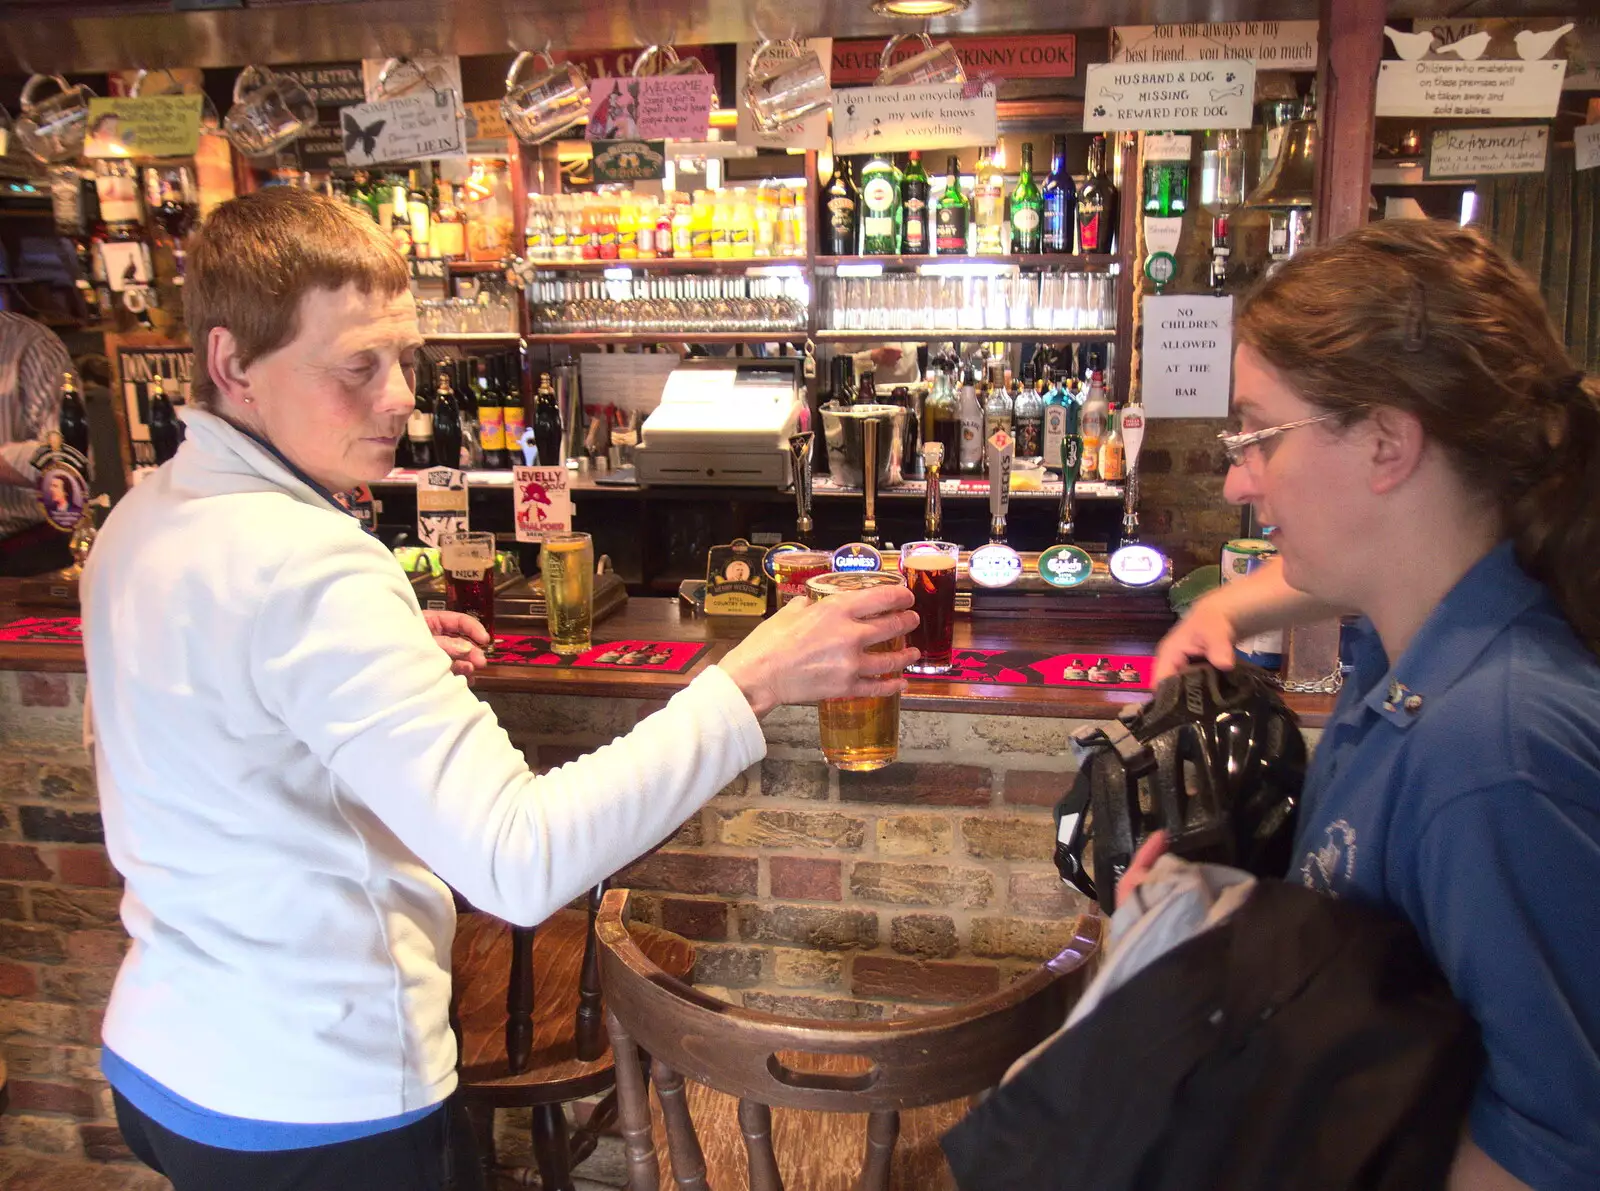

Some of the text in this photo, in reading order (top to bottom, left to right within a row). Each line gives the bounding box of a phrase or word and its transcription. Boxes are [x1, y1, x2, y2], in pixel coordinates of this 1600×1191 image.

[1202, 23, 1242, 40] always
[1244, 22, 1259, 37] be
[1263, 22, 1281, 39] my
[833, 50, 882, 70] NEVER
[957, 46, 1018, 68] SKINNY
[1020, 44, 1072, 65] COOK
[1124, 47, 1147, 63] best
[1199, 46, 1219, 62] you
[1223, 44, 1256, 60] know
[1259, 42, 1278, 60] too
[1281, 42, 1313, 60] much
[1415, 62, 1525, 74] Children who misbehave
[1114, 71, 1215, 85] HUSBAND & DOG
[1420, 76, 1516, 90] on these premises will
[644, 80, 703, 93] WELCOME
[874, 91, 901, 103] need
[902, 91, 917, 102] an
[1138, 89, 1190, 102] MISSING
[1425, 91, 1505, 103] be taken away and
[888, 105, 977, 121] my wife knows
[1117, 105, 1229, 120] REWARD FOR DOG
[905, 122, 963, 136] everything
[1178, 308, 1193, 317] NO
[1160, 320, 1218, 329] CHILDREN
[1160, 340, 1217, 349] ALLOWED
[1165, 364, 1211, 373] AT THE
[1174, 388, 1197, 397] BAR
[516, 471, 562, 482] LEVELLY
[836, 556, 875, 568] GUINNESS
[455, 570, 480, 578] NICK
